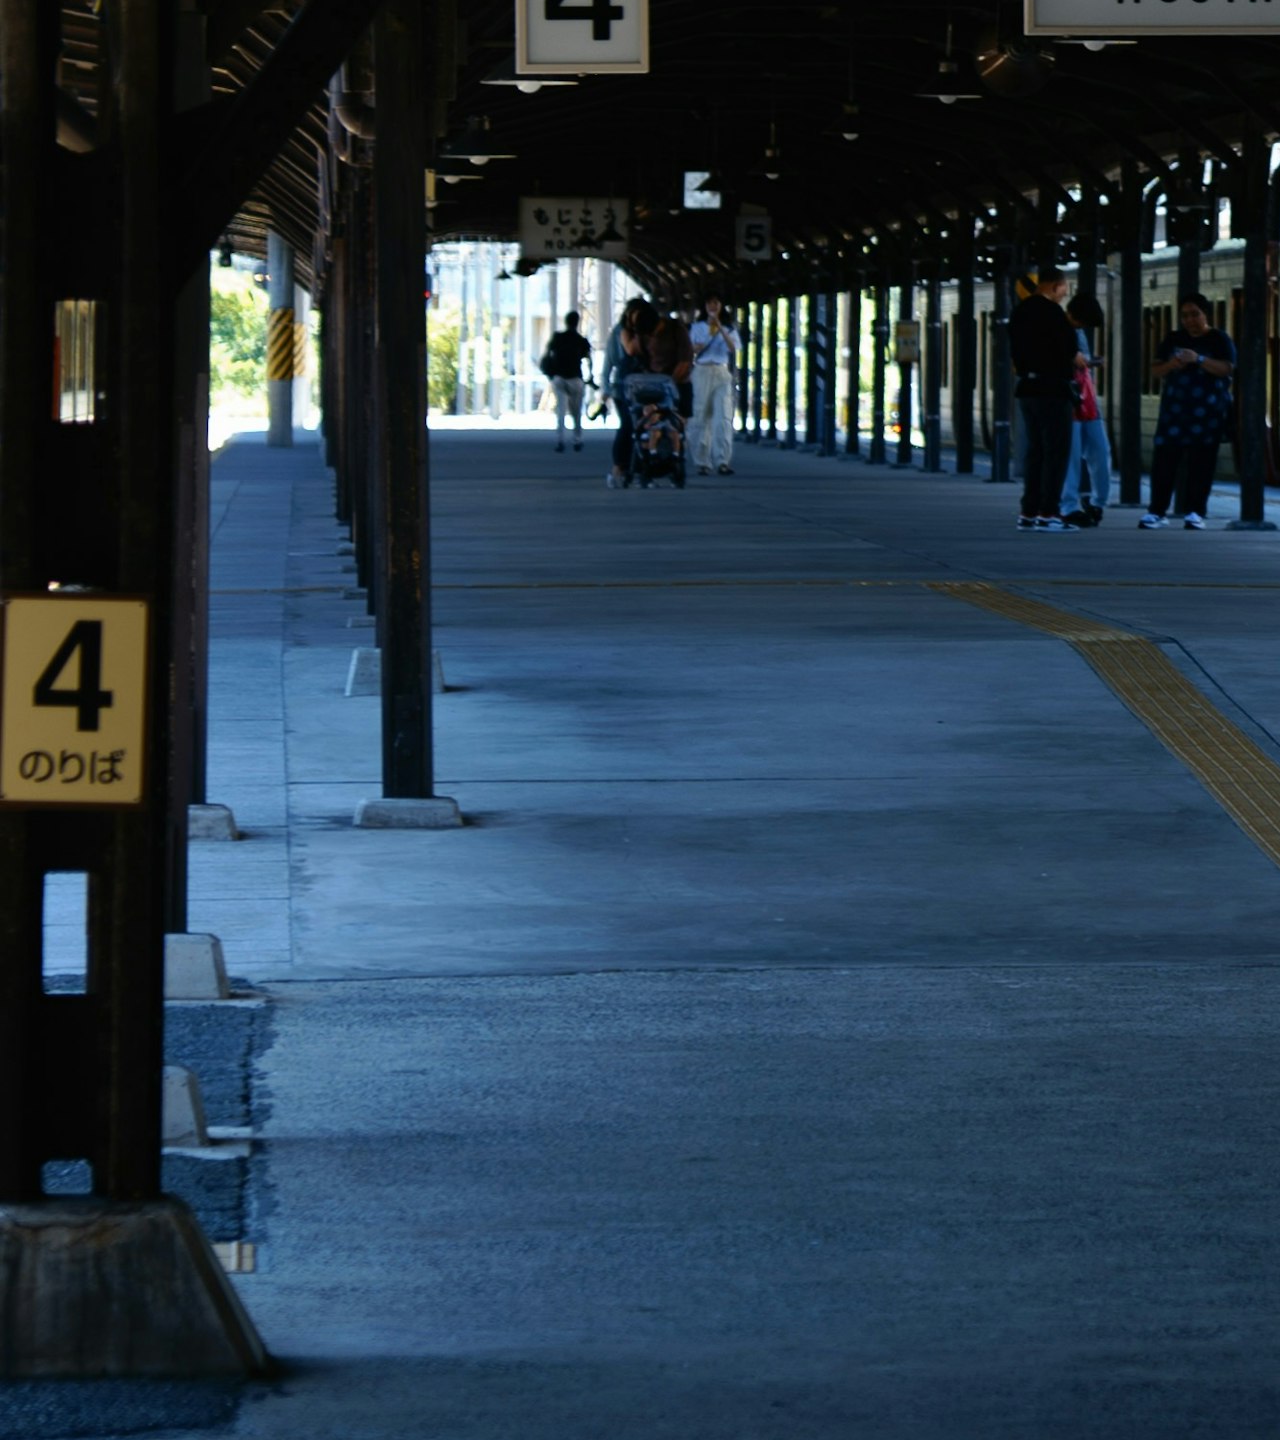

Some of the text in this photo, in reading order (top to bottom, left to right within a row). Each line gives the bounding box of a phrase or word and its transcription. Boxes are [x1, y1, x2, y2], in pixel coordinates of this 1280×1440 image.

[743, 224, 767, 252] 5
[33, 620, 113, 732] 4
[19, 749, 126, 786] のりば
